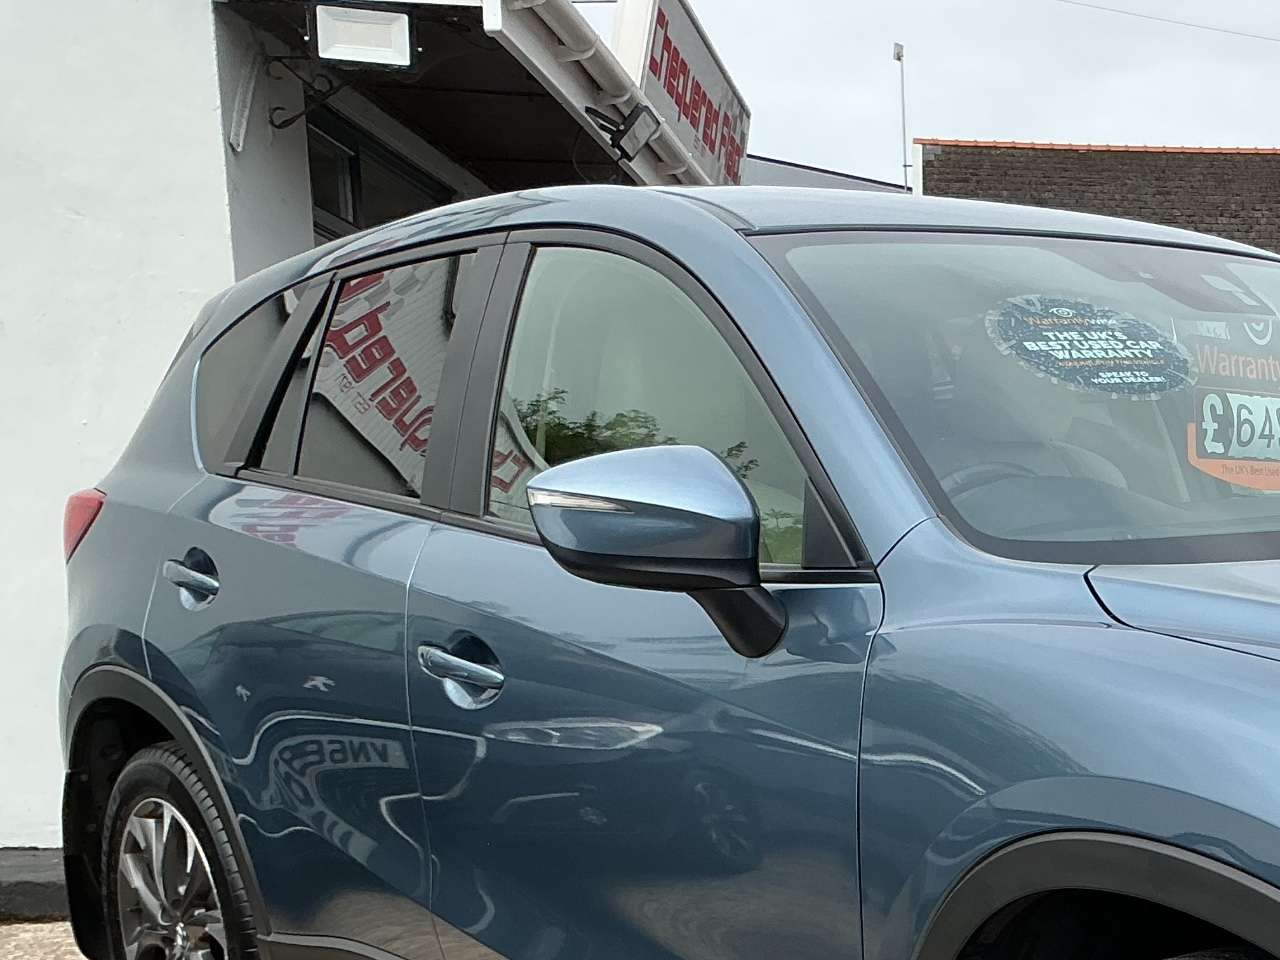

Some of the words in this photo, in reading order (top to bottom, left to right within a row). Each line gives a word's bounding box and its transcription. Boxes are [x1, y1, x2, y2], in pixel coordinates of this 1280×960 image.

[649, 7, 721, 156] Chequered
[1042, 330, 1083, 341] THE
[1086, 330, 1129, 341] UK'S
[1022, 341, 1073, 352] BEST
[1075, 340, 1124, 350] USED
[1126, 340, 1164, 350] CAR
[1049, 349, 1154, 360] WARRANTY
[1098, 371, 1133, 379] SPEAK
[1091, 377, 1122, 385] YOUR
